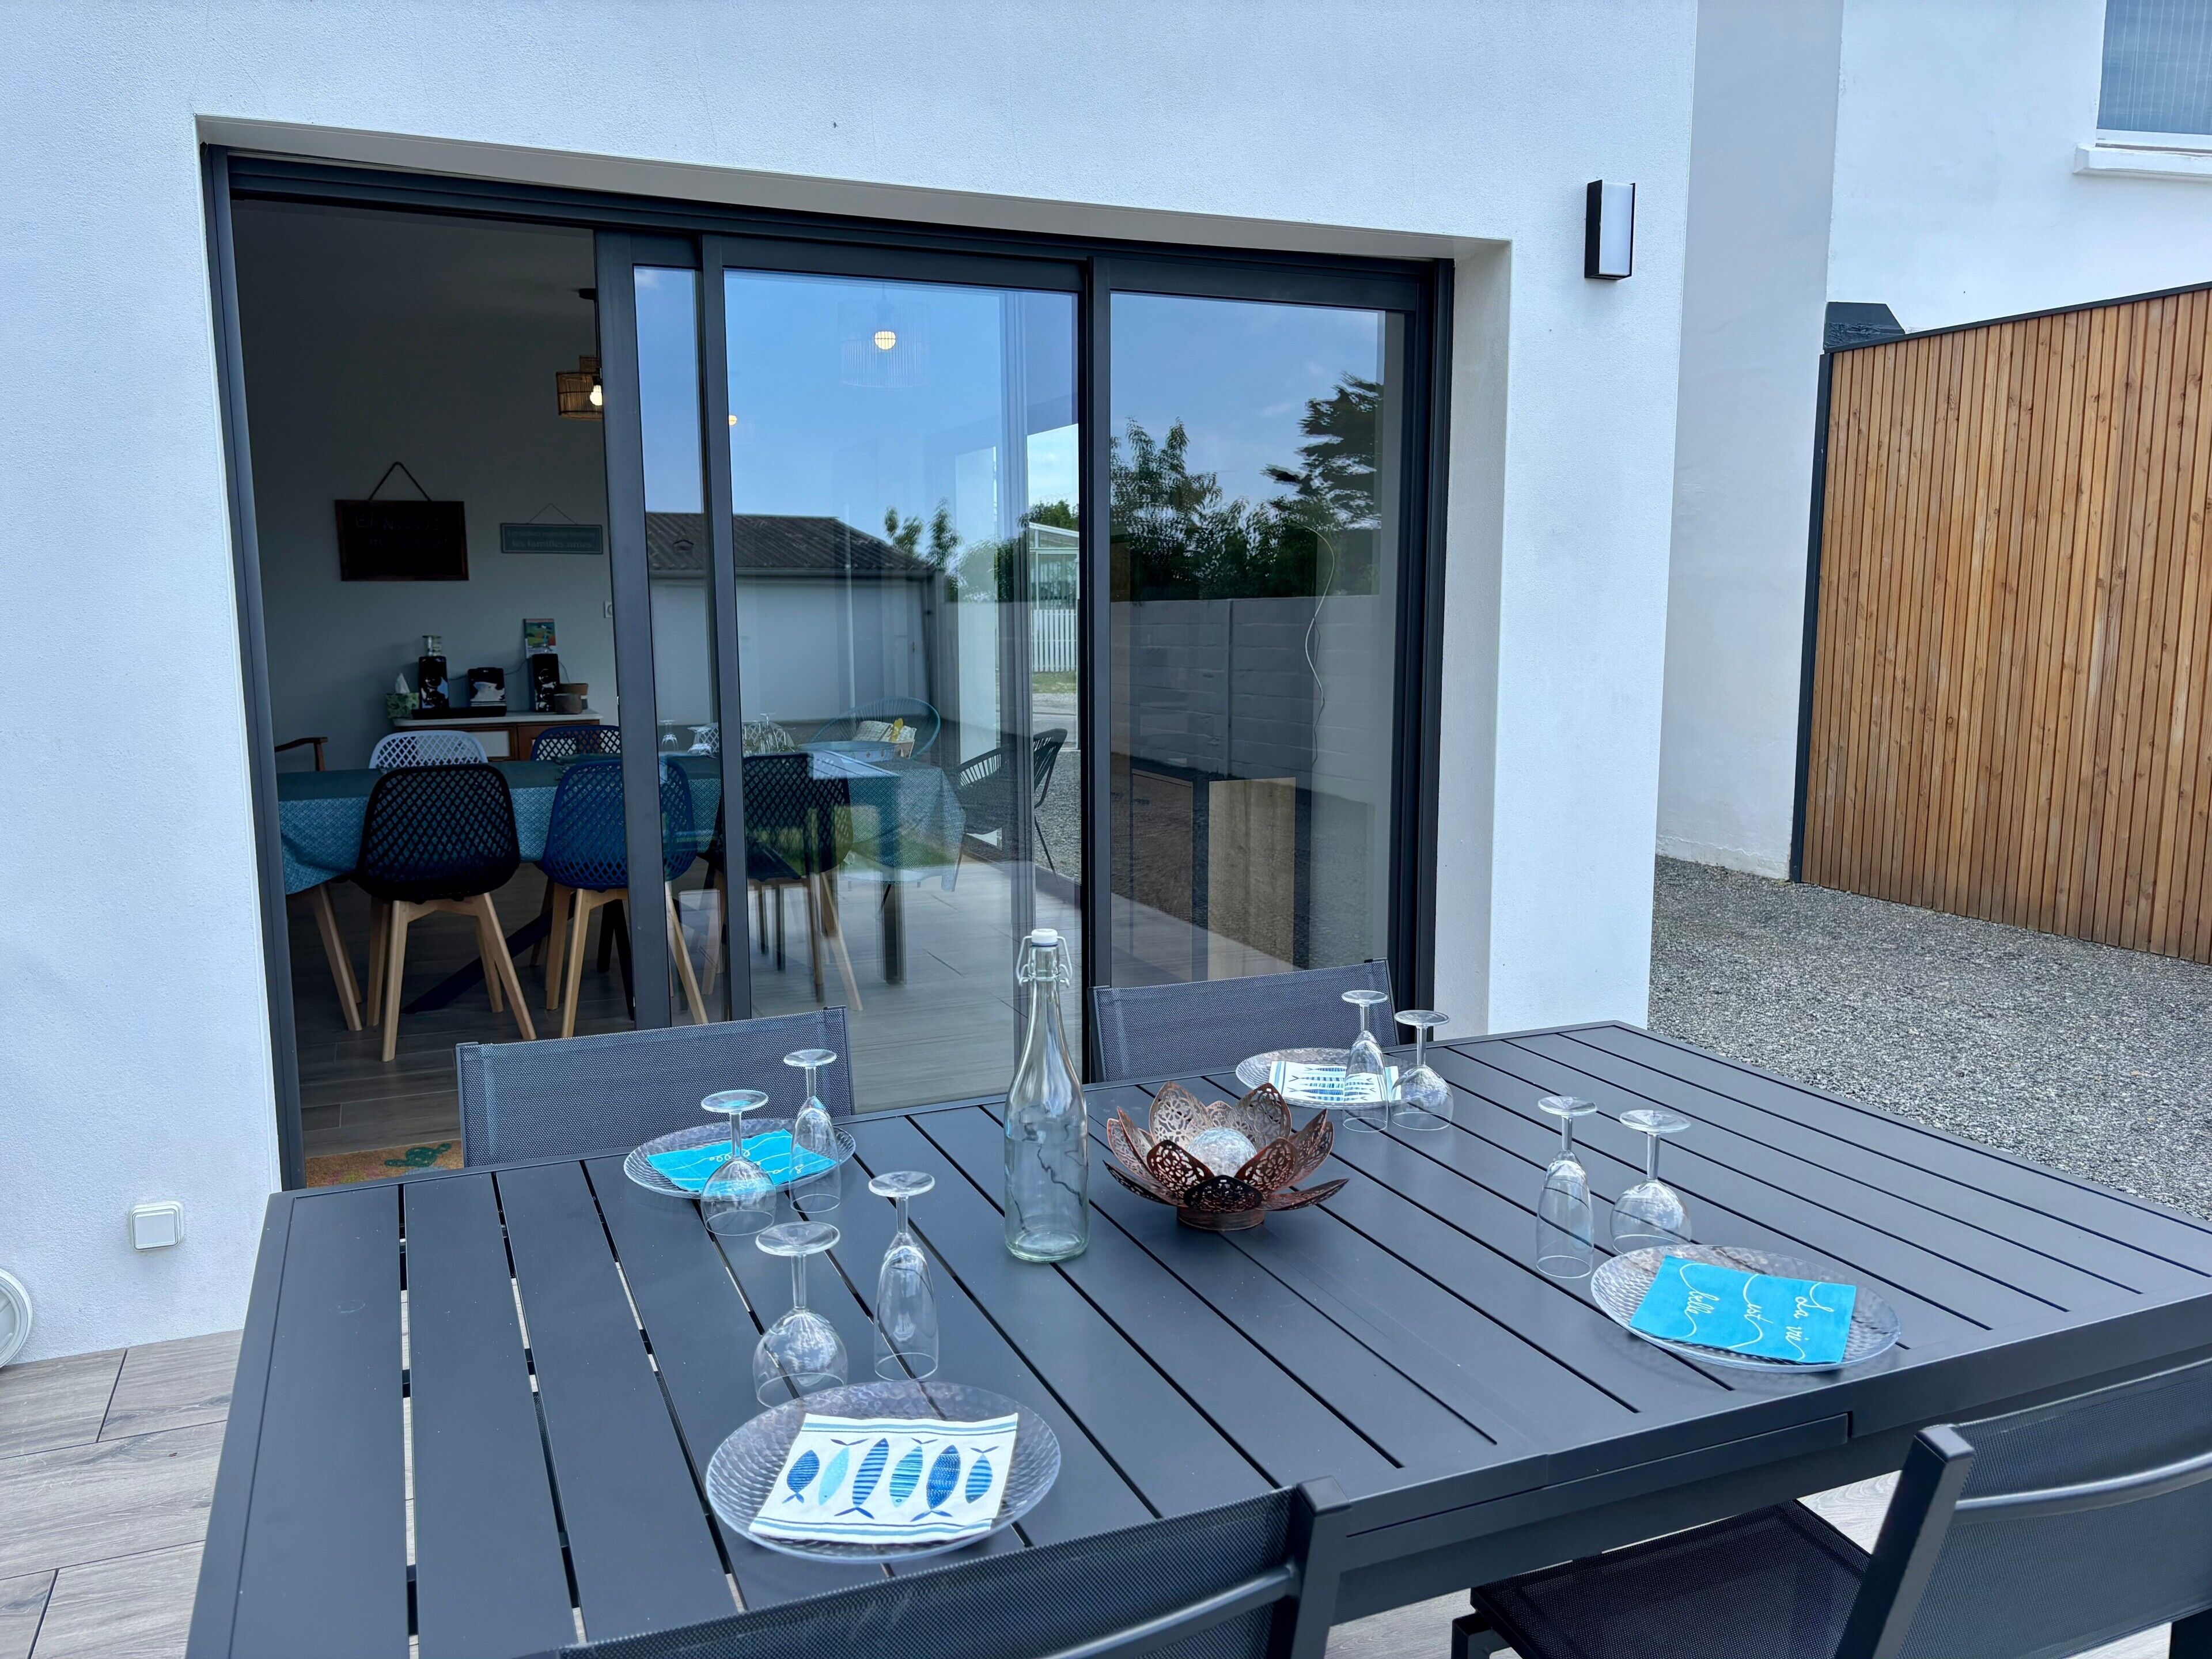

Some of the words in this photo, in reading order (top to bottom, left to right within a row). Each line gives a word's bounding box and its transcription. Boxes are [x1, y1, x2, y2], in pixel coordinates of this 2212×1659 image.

[1683, 1288, 1720, 1316] belle
[1743, 1302, 1774, 1324] est
[1793, 1290, 1835, 1319] La
[1785, 1325, 1810, 1342] vie
